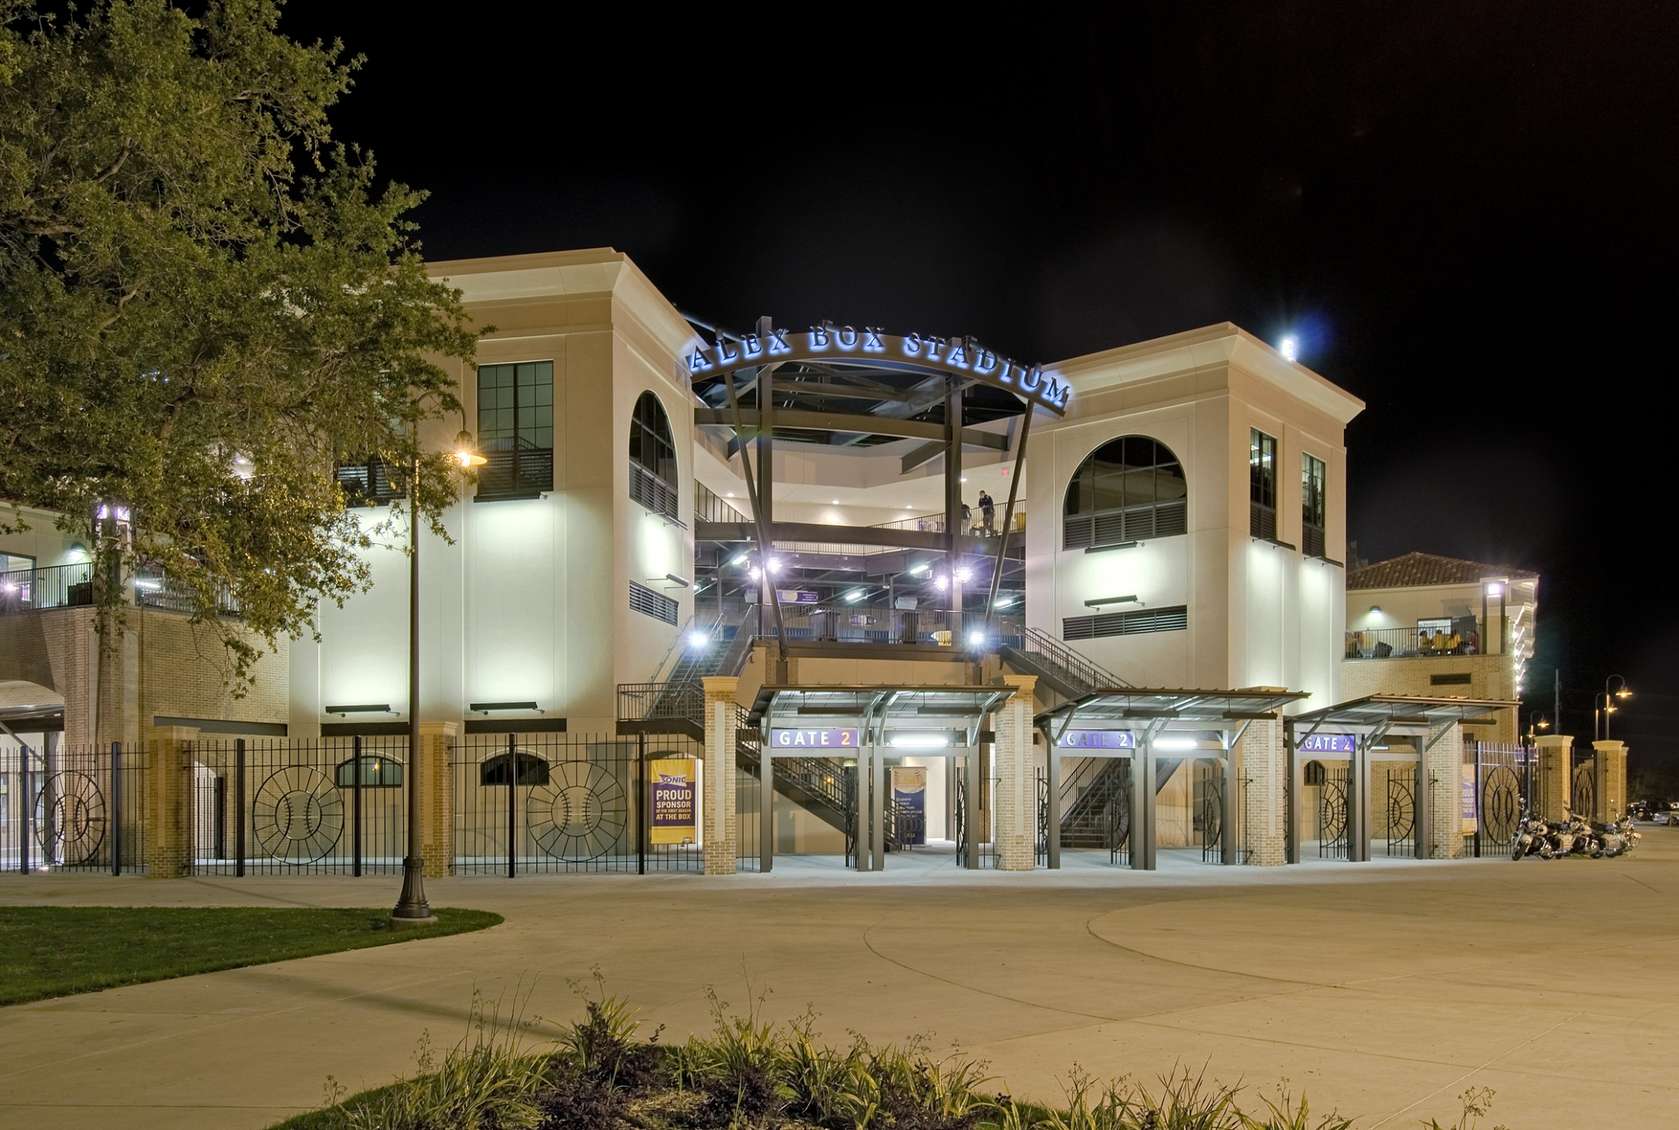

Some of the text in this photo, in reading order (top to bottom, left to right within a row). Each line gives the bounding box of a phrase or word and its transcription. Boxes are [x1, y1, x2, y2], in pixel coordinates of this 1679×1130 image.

[688, 325, 1070, 406] ALEX BOX STADIUM
[779, 731, 850, 746] GATE 2
[1119, 734, 1128, 747] 2
[1304, 736, 1351, 750] GATE 2
[656, 790, 692, 801] PROUD
[656, 801, 691, 809] SPONSOR
